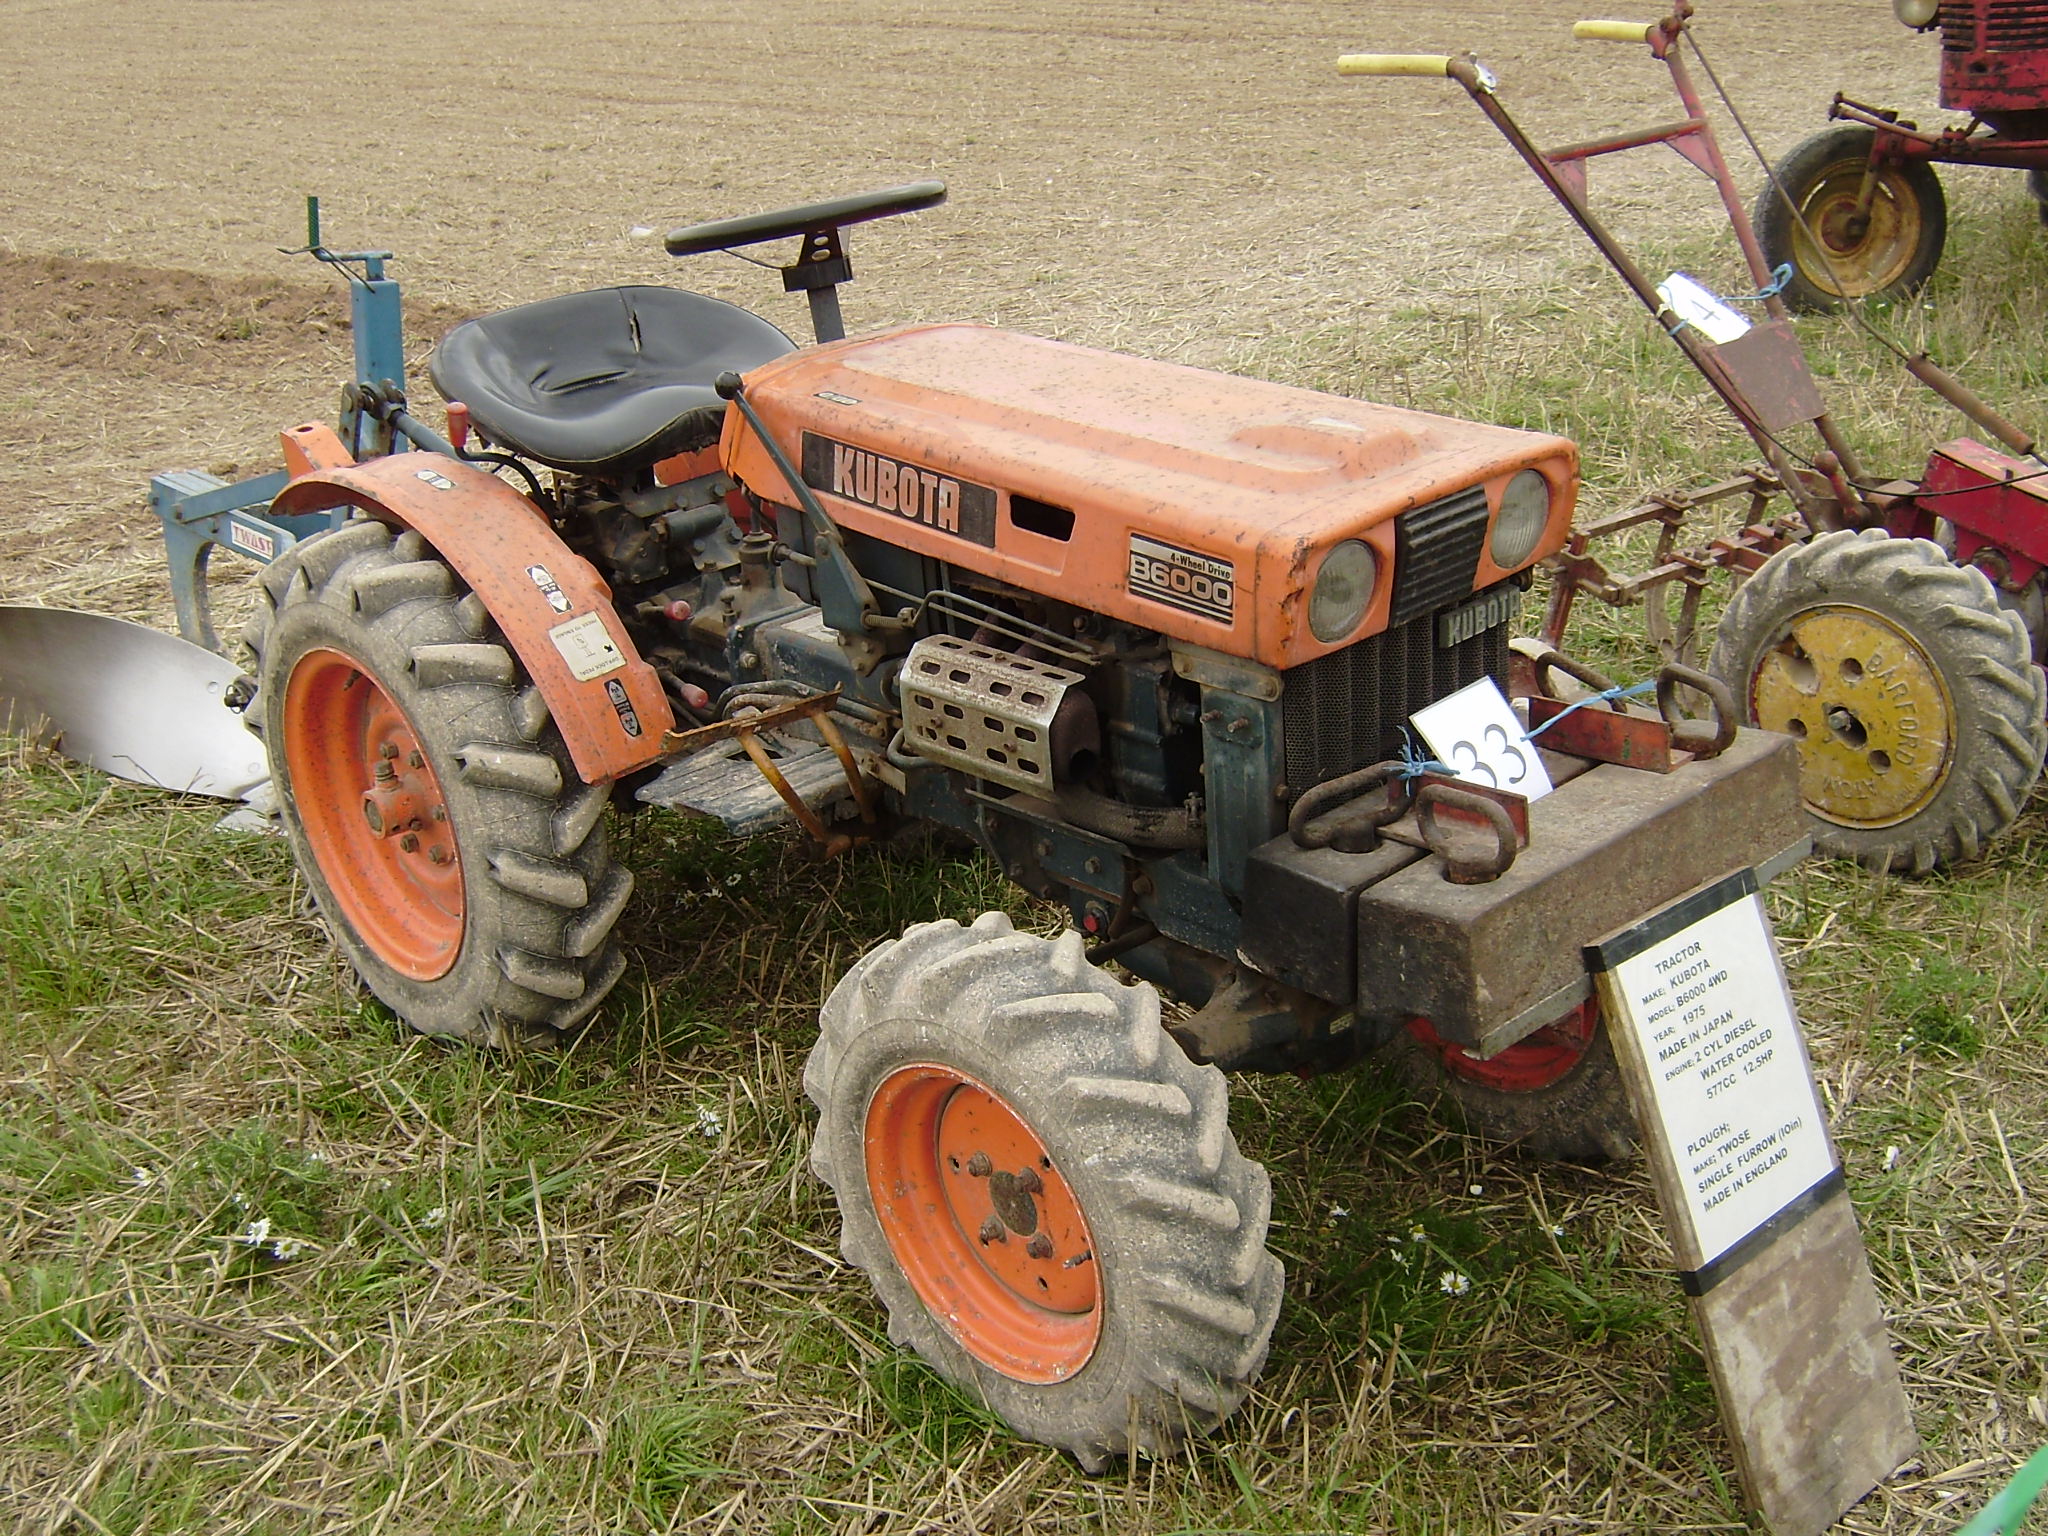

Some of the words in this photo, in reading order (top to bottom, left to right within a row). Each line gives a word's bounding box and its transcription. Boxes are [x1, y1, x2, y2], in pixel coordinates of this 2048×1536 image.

[1690, 299, 1720, 320] 4
[833, 444, 960, 533] KUBOTA
[1129, 553, 1233, 606] B6000
[1170, 552, 1206, 572] 4-Wheel
[1207, 563, 1231, 580] Drive
[1448, 587, 1521, 648] KUBOTA
[1865, 652, 1920, 767] BARFORD
[1452, 723, 1527, 789] 33
[1655, 941, 1702, 974] TRACTOR
[1669, 958, 1711, 989] KUBOTA
[1676, 982, 1706, 1007] B6000
[1708, 969, 1728, 988] 4WD
[1658, 1037, 1691, 1062] MADE
[1689, 1030, 1700, 1044] IN
[1703, 1009, 1734, 1036] JAPAN
[1682, 1004, 1706, 1025] 1975
[1695, 1051, 1702, 1063] 2
[1703, 1039, 1723, 1057] CYL
[1724, 1018, 1757, 1045] DIESEL
[1700, 1052, 1735, 1080] WATER
[1736, 1028, 1773, 1058] COOLED
[1706, 1073, 1737, 1099] 577CC
[1743, 1049, 1774, 1075] 12.5HP
[1698, 1163, 1734, 1193] SINGLE
[1737, 1132, 1777, 1167] FURROW
[1717, 1129, 1751, 1157] TWOSE
[1703, 1187, 1732, 1212] MADE
[1732, 1178, 1744, 1192] IN
[1745, 1147, 1788, 1183] ENGLAND
